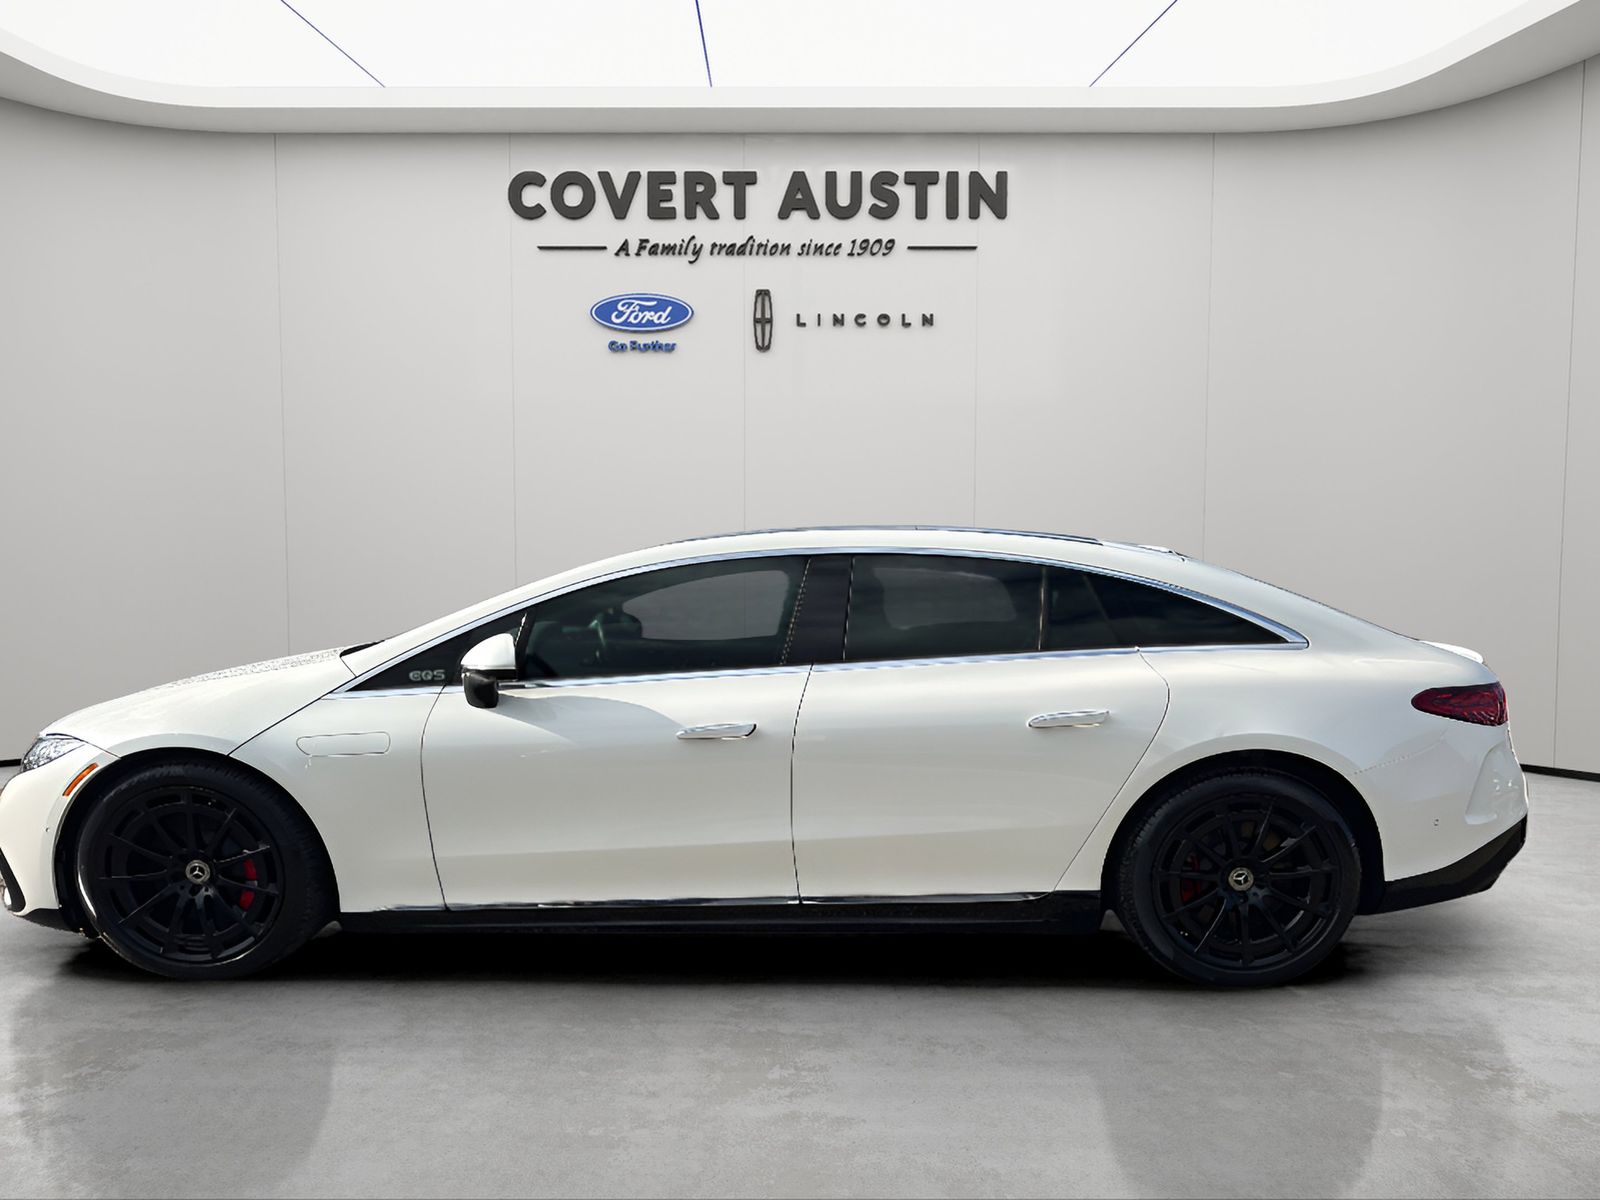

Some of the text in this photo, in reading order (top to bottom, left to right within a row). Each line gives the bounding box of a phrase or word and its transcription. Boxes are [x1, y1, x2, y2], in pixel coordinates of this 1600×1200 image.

[508, 170, 1009, 220] COVERT AUSTIN
[614, 235, 896, 265] A Family tradition since 1909
[611, 299, 672, 325] Ford
[796, 313, 935, 328] LINCOLN
